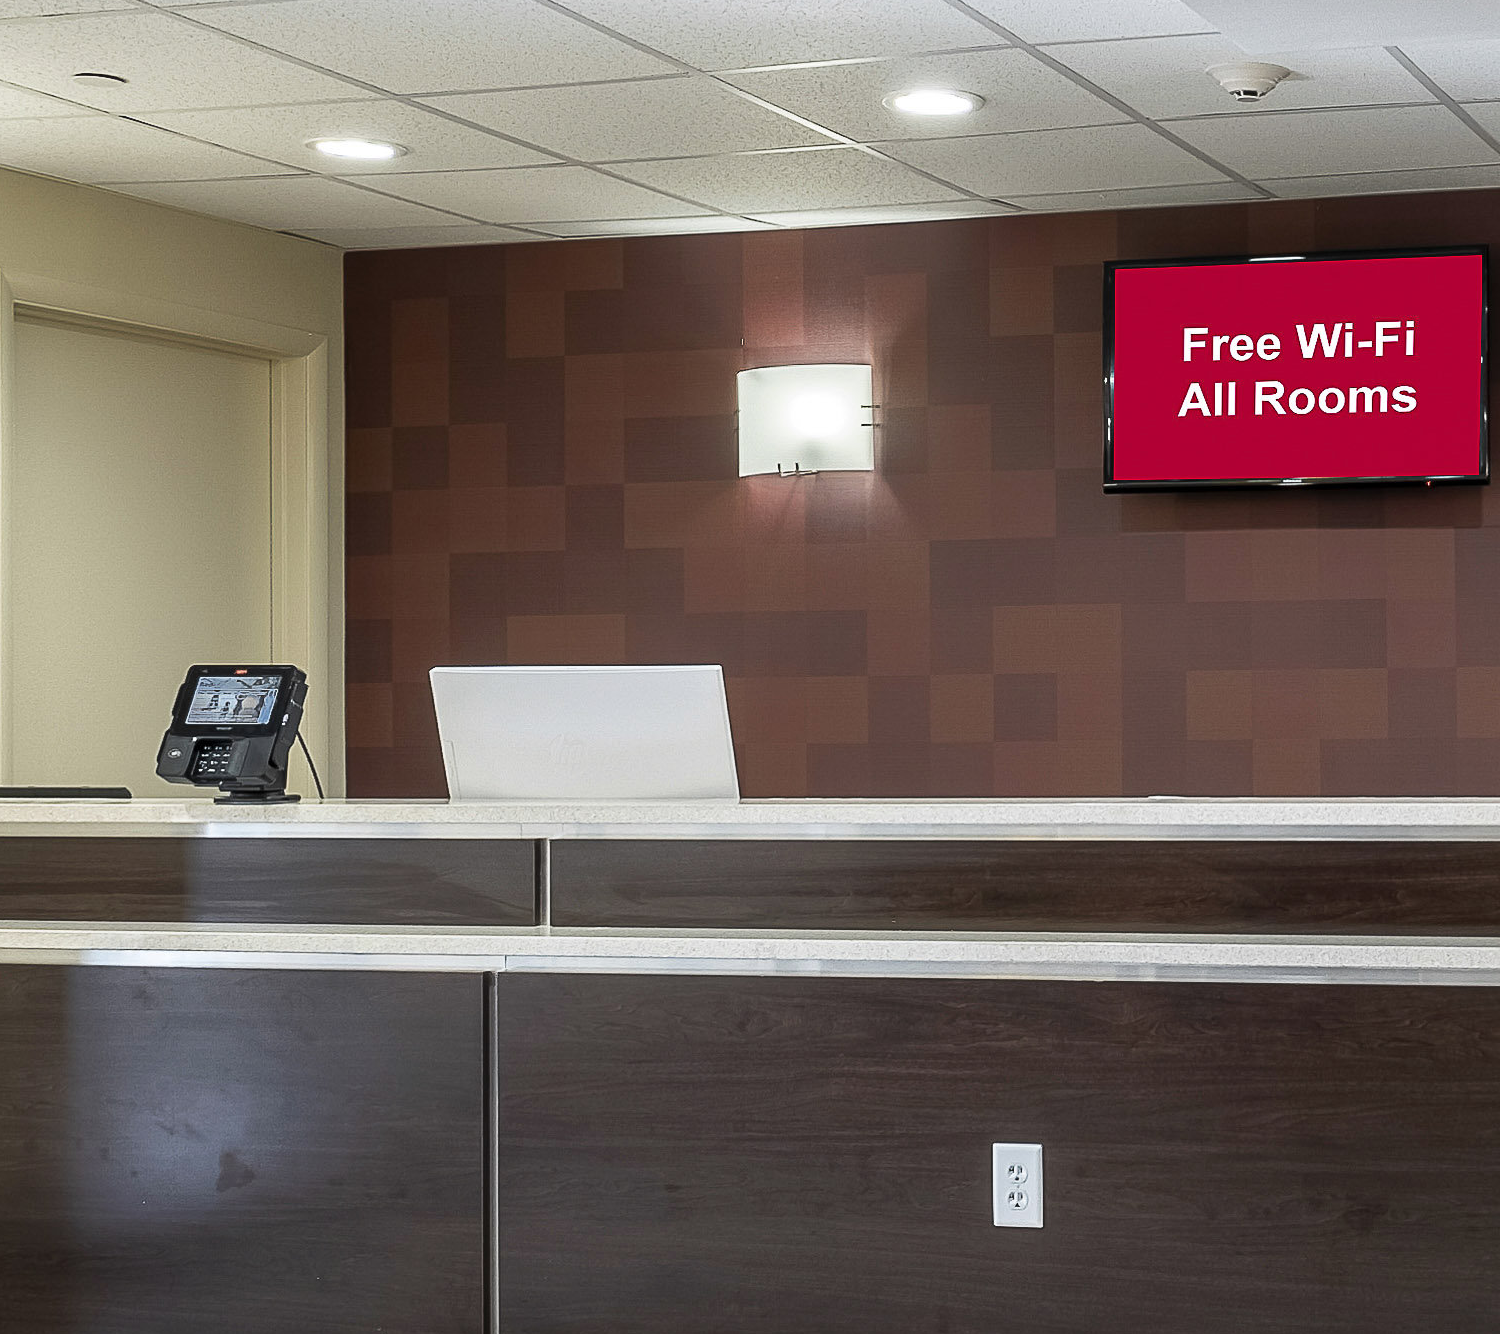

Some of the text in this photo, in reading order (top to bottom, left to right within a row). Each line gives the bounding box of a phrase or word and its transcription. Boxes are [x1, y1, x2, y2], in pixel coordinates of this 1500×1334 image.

[1183, 320, 1415, 362] Free Wi-Fi
[1177, 380, 1417, 417] All Rooms
